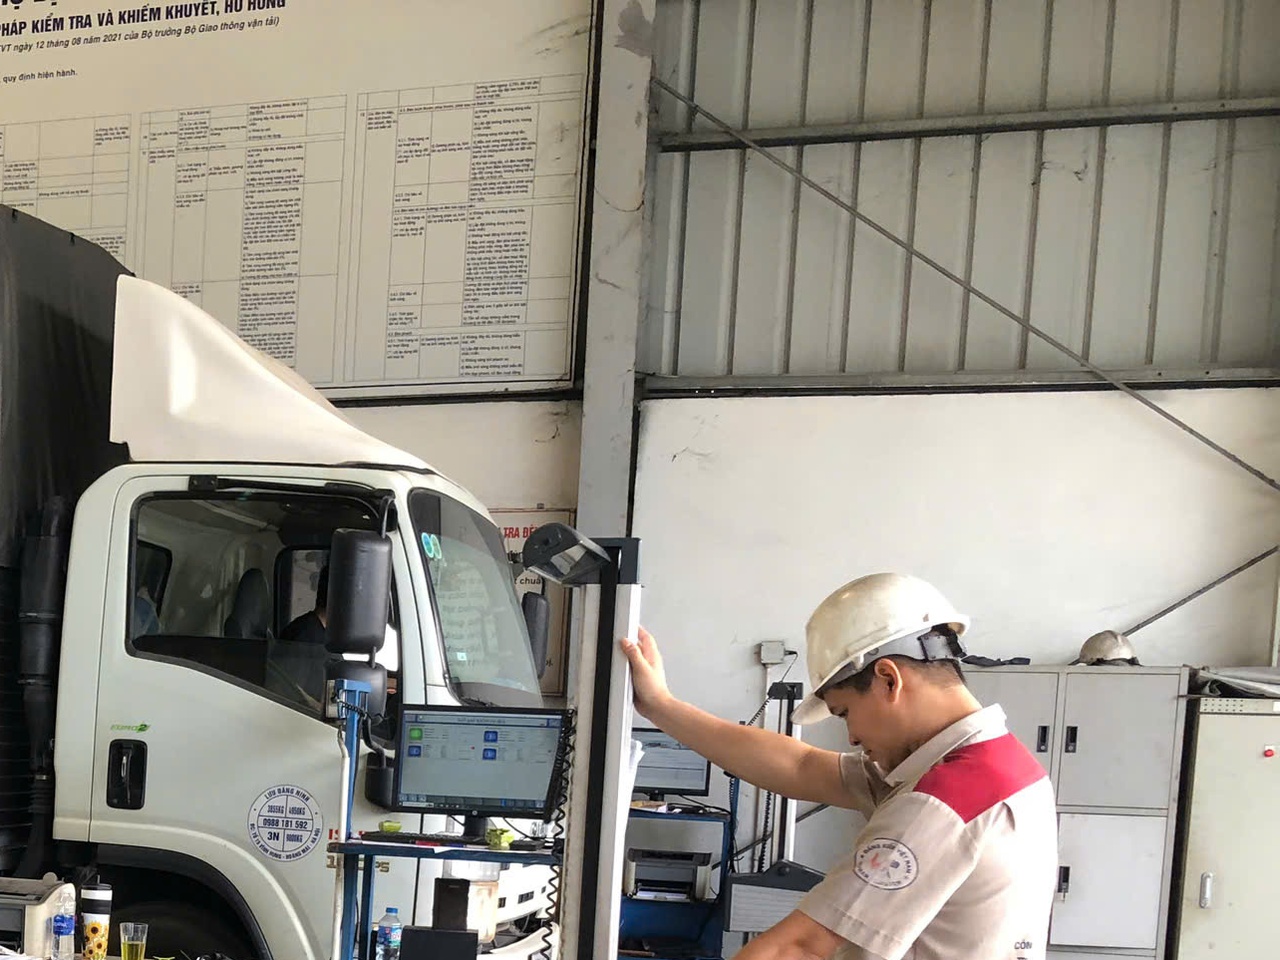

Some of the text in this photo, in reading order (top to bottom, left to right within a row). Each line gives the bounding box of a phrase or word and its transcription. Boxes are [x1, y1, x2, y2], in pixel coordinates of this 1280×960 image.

[31, 13, 64, 33] KIỂM
[68, 15, 91, 29] TRA
[97, 9, 113, 26] VÀ
[118, 4, 160, 24] KHIẾM
[166, 0, 219, 19] KHUYẾT,
[13, 42, 32, 53] ngày
[46, 40, 69, 48] tháng
[71, 37, 80, 45] 08
[82, 36, 100, 44] năm
[103, 33, 120, 42] 2021
[124, 31, 138, 40] của
[140, 30, 151, 39] Bộ
[154, 27, 181, 37] trưởng
[184, 25, 196, 34] Bộ
[198, 24, 218, 32] Giao
[220, 21, 244, 30] thông
[247, 19, 262, 29] vận
[265, 17, 278, 26] tải)
[503, 526, 519, 538] TRA
[263, 818, 279, 827] 0988
[295, 821, 308, 829] 592
[267, 831, 279, 841] 3N
